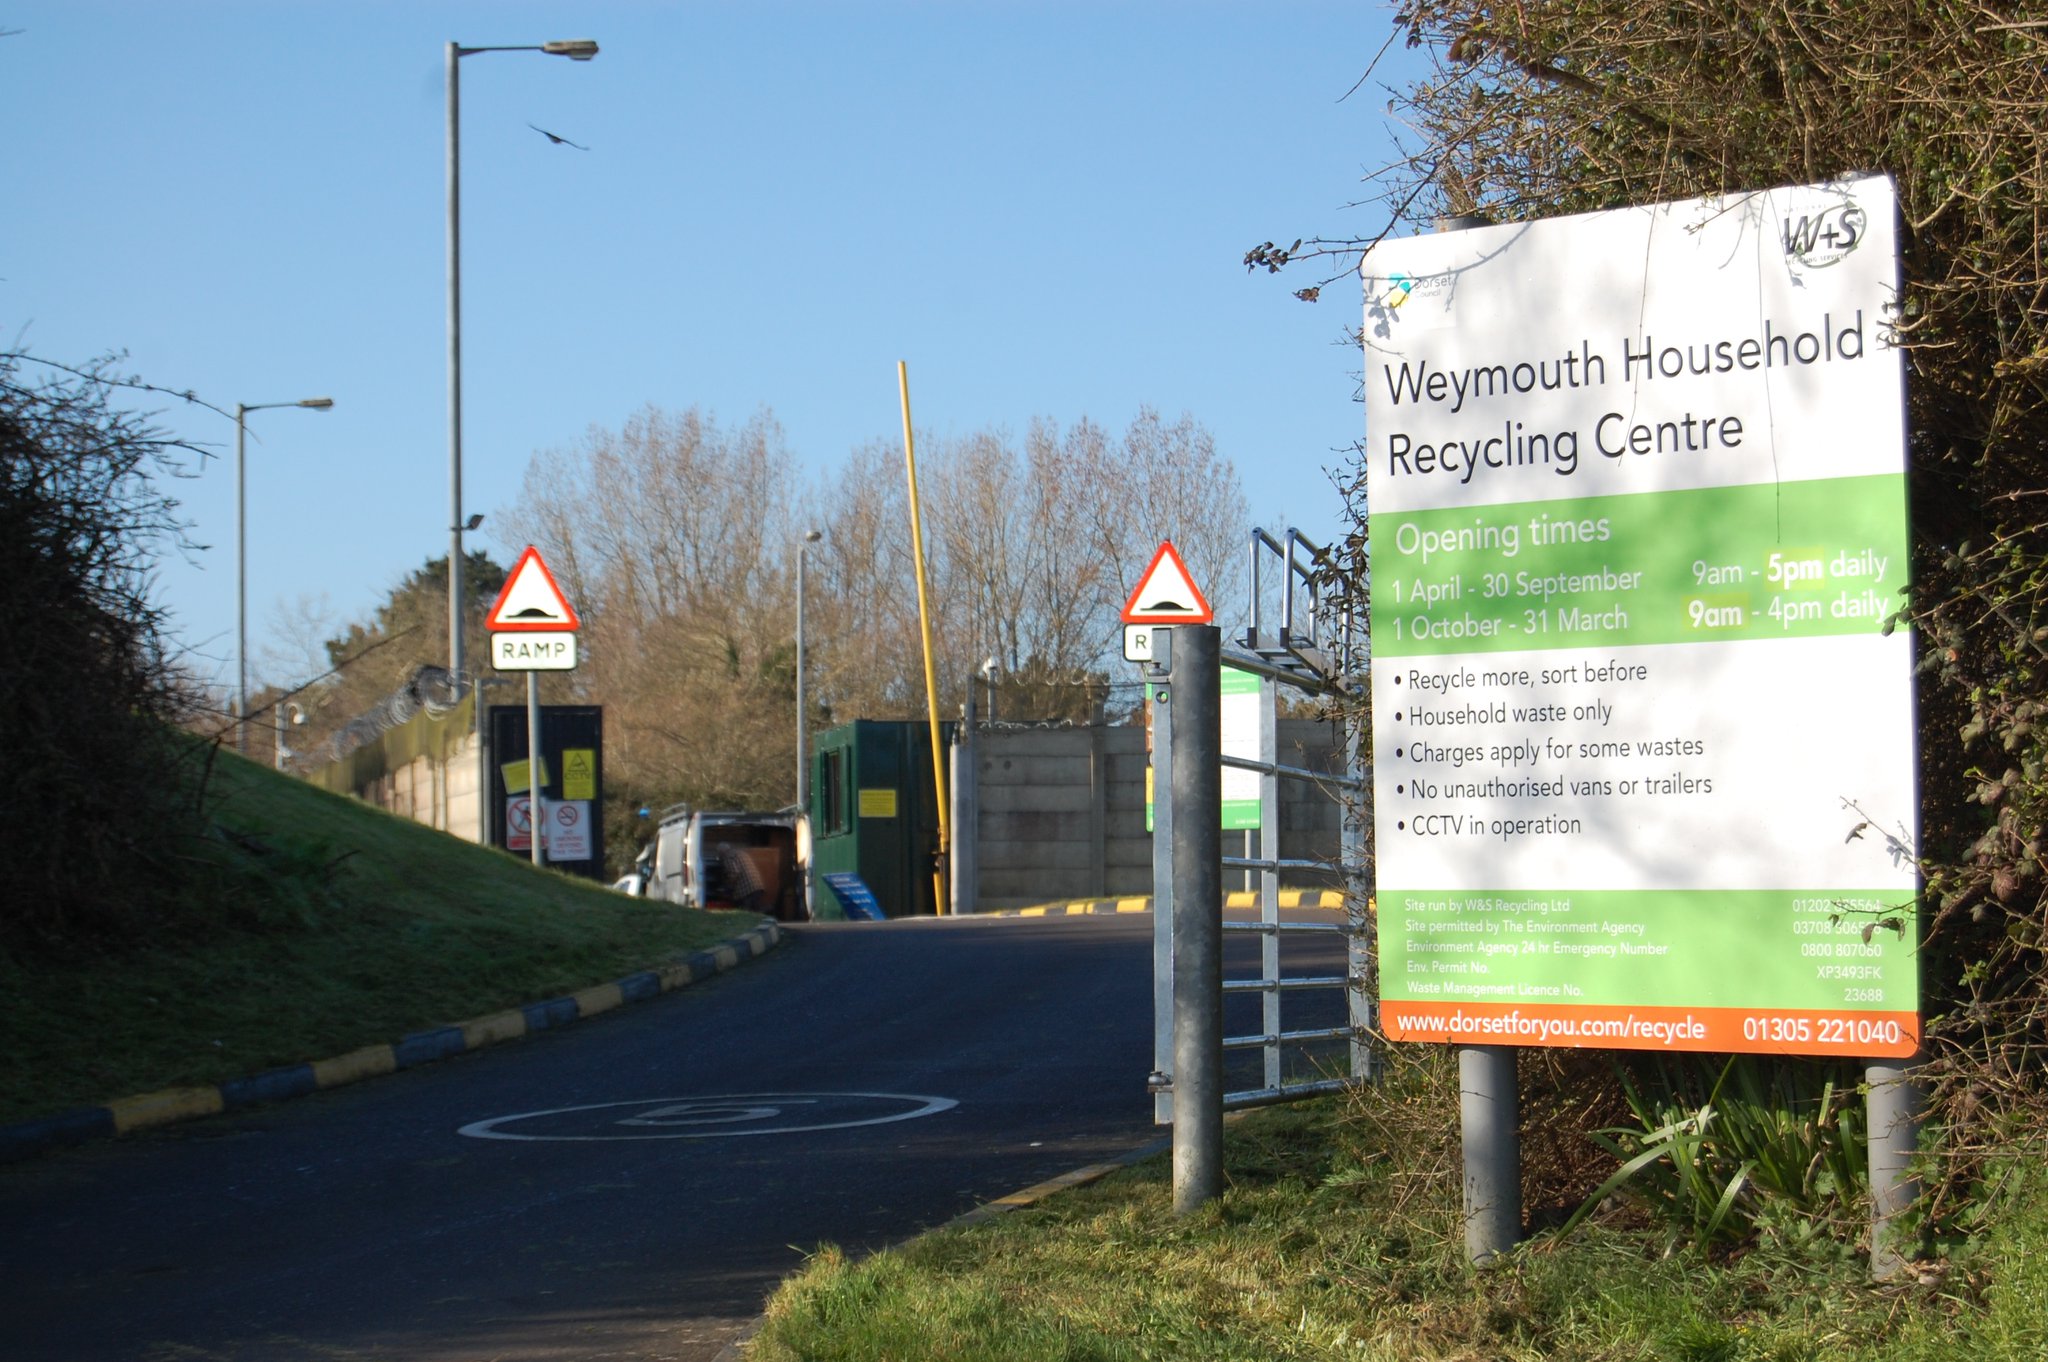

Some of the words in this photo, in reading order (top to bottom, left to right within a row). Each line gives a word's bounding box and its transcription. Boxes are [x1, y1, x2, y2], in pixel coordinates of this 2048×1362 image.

[1384, 339, 1605, 413] Weymouth
[1624, 309, 1864, 382] Household
[1389, 421, 1578, 484] Recycling
[1595, 412, 1743, 458] Centre
[1396, 518, 1520, 564] Opening
[1528, 513, 1611, 546] times
[1392, 580, 1401, 603] 1
[1410, 575, 1461, 610] April
[1482, 573, 1509, 598] 30
[1516, 565, 1643, 603] September
[1692, 559, 1743, 585] 9am
[1767, 553, 1823, 590] 5pm
[1829, 548, 1888, 583] daily
[1392, 617, 1401, 640] 1
[1411, 611, 1502, 640] October
[1523, 609, 1547, 634] 31
[1558, 604, 1628, 633] March
[1688, 599, 1743, 629] 9am
[1767, 595, 1822, 630] 4pm
[1830, 588, 1889, 624] daily
[502, 642, 566, 659] RAMP
[1409, 666, 1476, 694] Recycle
[1482, 670, 1535, 688] more,
[1541, 666, 1578, 685] sort
[1584, 659, 1648, 683] before
[1409, 702, 1506, 726] Household
[1512, 703, 1567, 723] waste
[1573, 698, 1612, 726] only
[1410, 741, 1484, 768] Charges
[1490, 738, 1541, 768] apply
[1546, 737, 1573, 759] for
[1579, 741, 1631, 759] some
[1636, 737, 1704, 757] wastes
[1411, 779, 1438, 800] No
[1443, 774, 1564, 799] unauthorised
[1570, 778, 1612, 796] vans
[1618, 777, 1638, 796] or
[1644, 771, 1712, 795] trailers
[1412, 814, 1464, 836] CCTV
[1469, 815, 1485, 835] in
[1491, 813, 1582, 842] operation
[1404, 898, 1426, 912] Site
[1428, 901, 1447, 912] run
[1449, 898, 1463, 915] by
[1464, 899, 1493, 912] W&S
[1495, 898, 1548, 915] Recycling
[1551, 898, 1571, 912] Ltd
[1792, 898, 1831, 912] 01202
[1404, 919, 1426, 932] Site
[1428, 919, 1485, 936] permitted
[1486, 920, 1500, 936] by
[1502, 920, 1524, 933] The
[1526, 920, 1598, 933] Environment
[1601, 920, 1645, 937] Agency
[1793, 921, 1832, 935] 03708
[1835, 921, 1881, 935] 50656
[1406, 940, 1474, 953] Environment
[1477, 940, 1519, 956] Agency
[1521, 940, 1537, 954] 24
[1538, 941, 1550, 954] hr
[1553, 942, 1617, 958] Emergency
[1620, 942, 1669, 956] Number
[1801, 943, 1832, 957] 0800
[1835, 943, 1882, 957] 807060
[1407, 960, 1429, 973] Env.
[1432, 960, 1467, 973] Permit
[1470, 961, 1490, 974] No.
[1816, 966, 1882, 980] XP3493FK
[1406, 981, 1440, 994] Waste
[1443, 981, 1515, 998] Management
[1517, 983, 1560, 996] Licence
[1563, 983, 1584, 997] No.
[1844, 988, 1883, 1002] 23688
[1397, 1009, 1706, 1045] www.dorsetforyou.com/recycle
[1743, 1017, 1810, 1043] 01305
[1817, 1018, 1899, 1045] 221040
